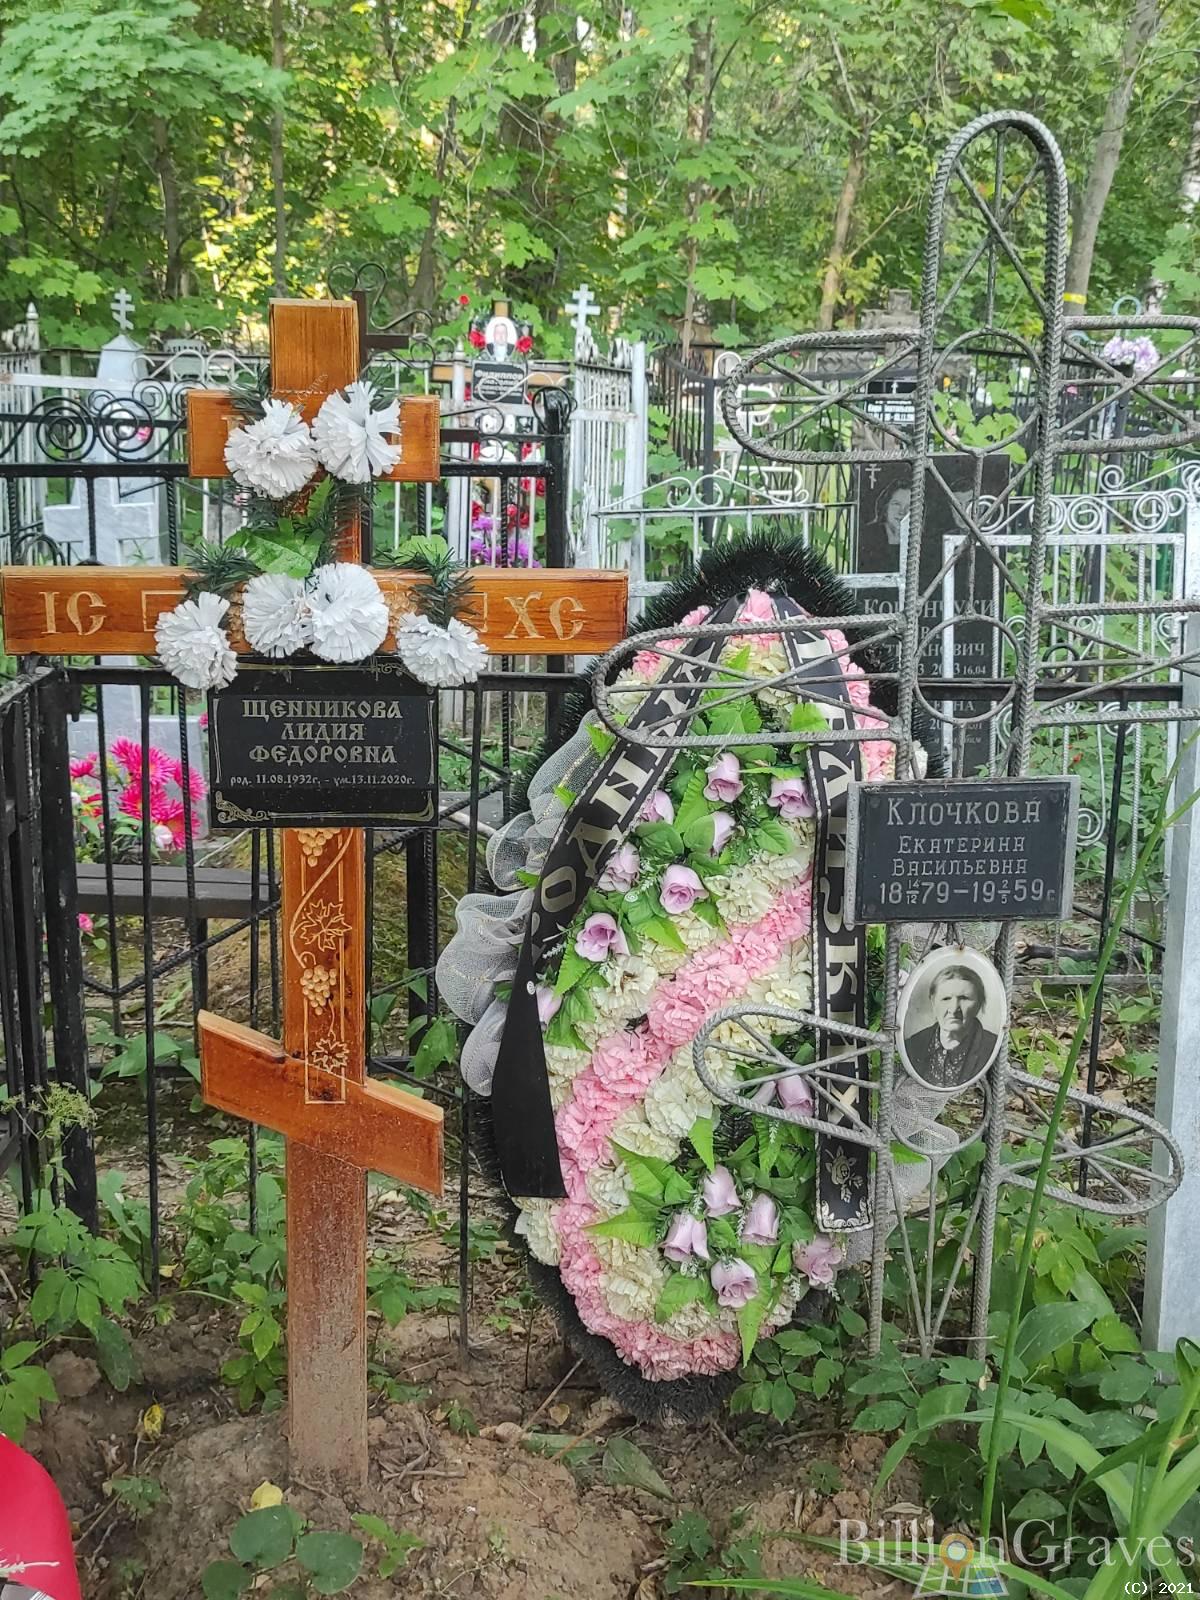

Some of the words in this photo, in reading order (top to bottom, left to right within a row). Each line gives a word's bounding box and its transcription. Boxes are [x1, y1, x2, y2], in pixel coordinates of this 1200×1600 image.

[242, 699, 403, 722] ЩЕННИКОВА
[281, 722, 365, 743] ЛИДИЯ
[249, 745, 397, 766] ФЕДОРОВНА
[230, 776, 252, 787] род.
